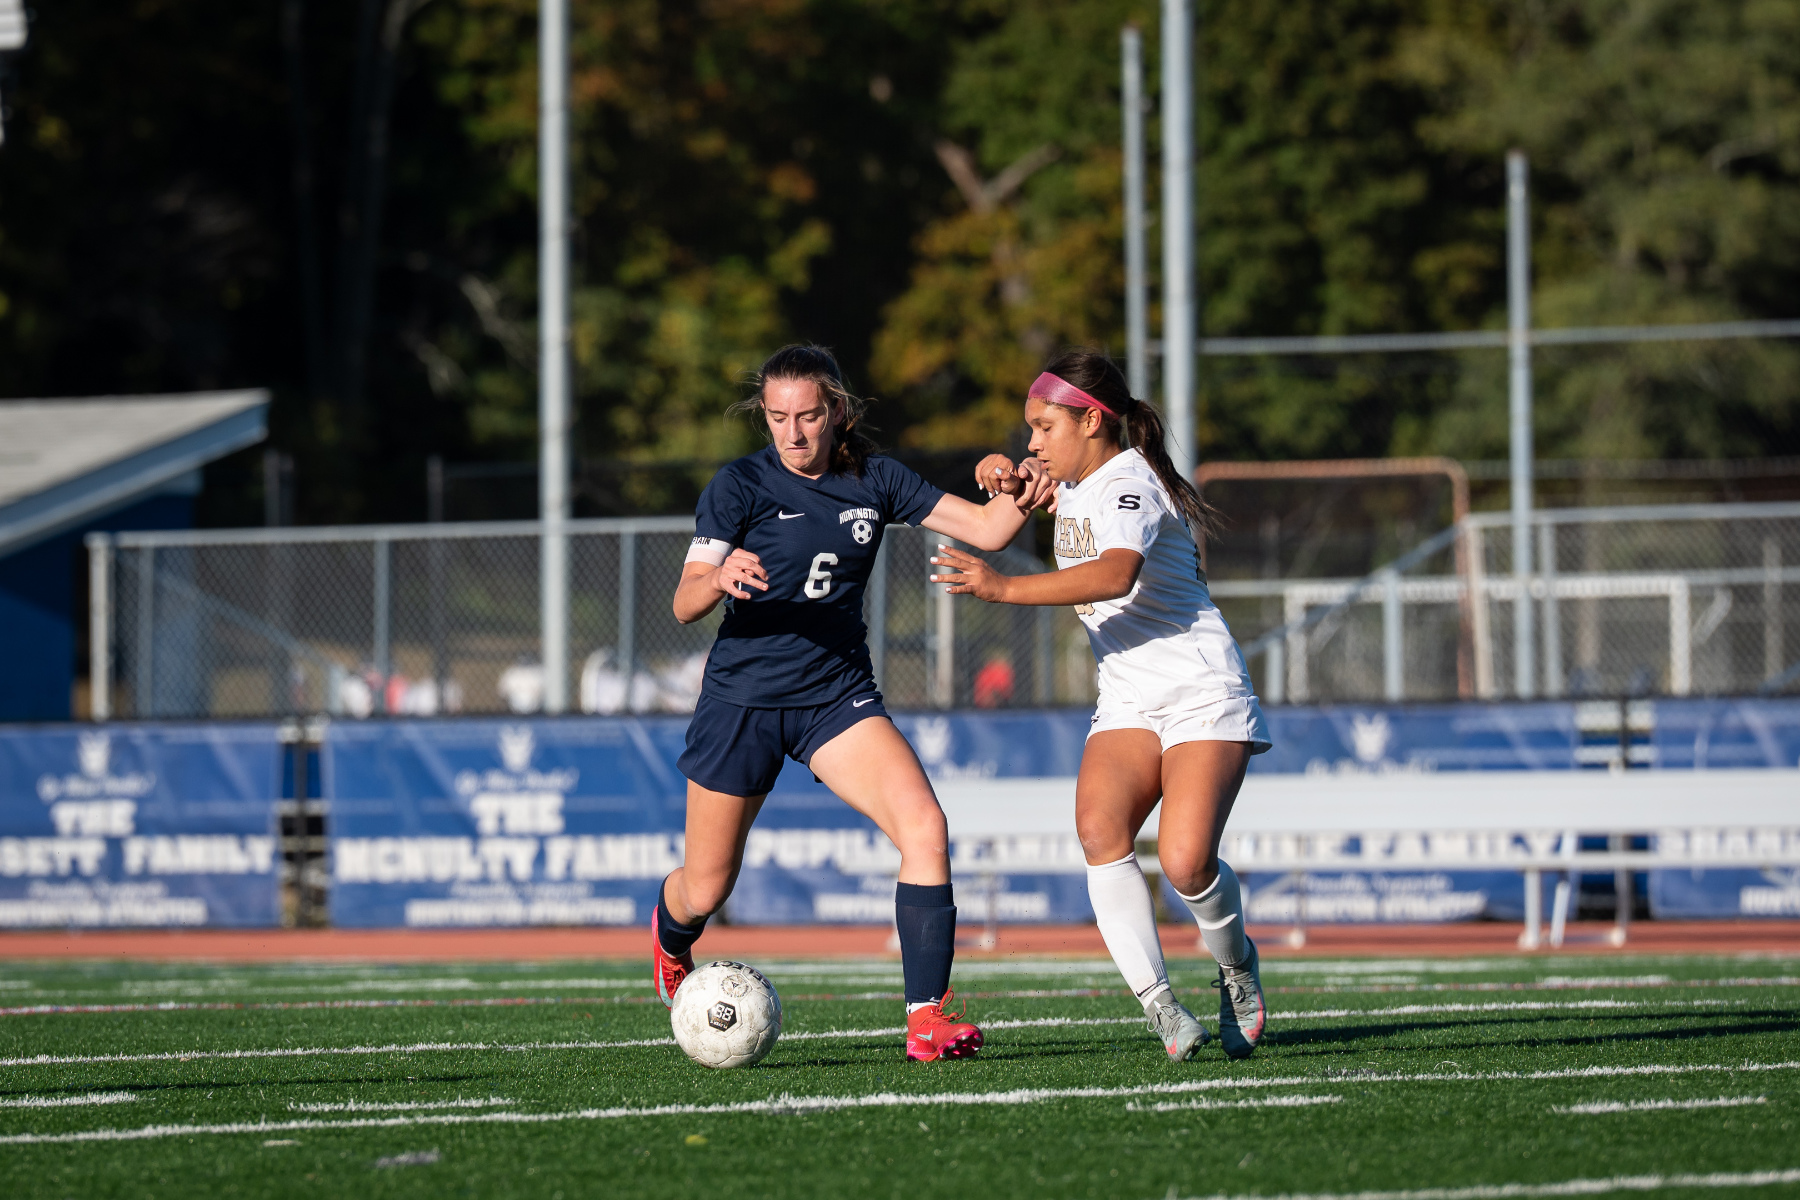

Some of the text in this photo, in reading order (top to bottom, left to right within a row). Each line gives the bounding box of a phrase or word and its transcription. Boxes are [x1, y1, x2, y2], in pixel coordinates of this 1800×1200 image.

[839, 508, 879, 524] HUNTINGTON
[1118, 494, 1141, 510] S
[804, 553, 839, 599] 6
[51, 800, 137, 836] THE
[470, 793, 565, 835] THE
[123, 834, 275, 875] FAMILY
